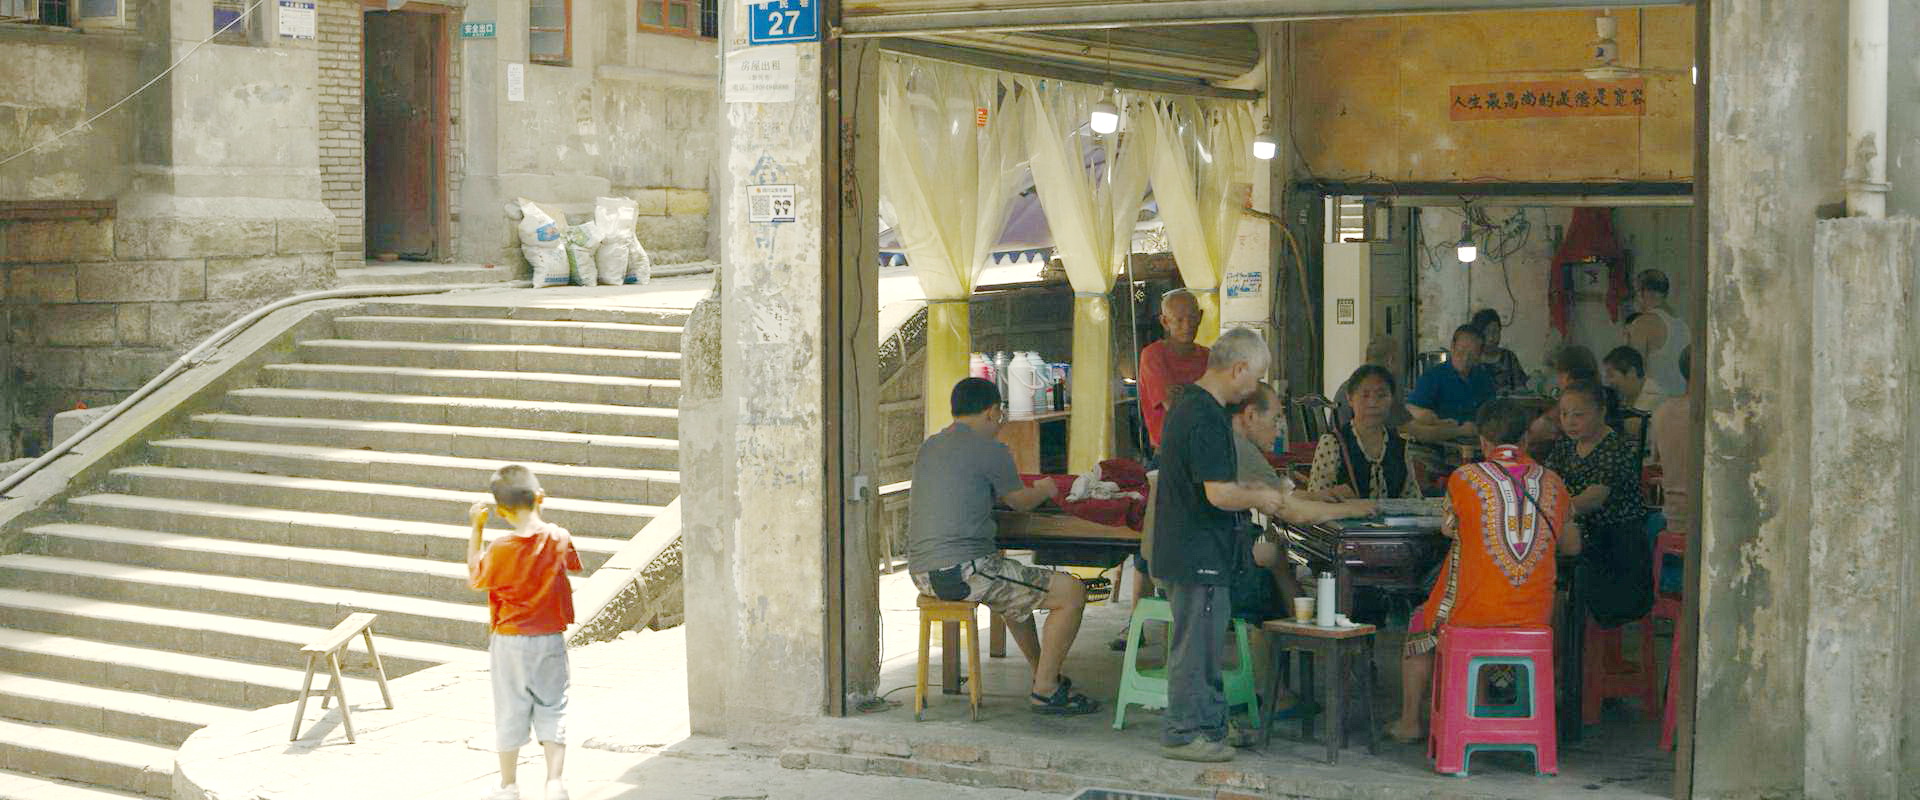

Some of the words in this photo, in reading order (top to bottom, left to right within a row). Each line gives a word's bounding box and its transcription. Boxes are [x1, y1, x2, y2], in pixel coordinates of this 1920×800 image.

[464, 24, 493, 33] 安全出口
[768, 10, 801, 35] 27
